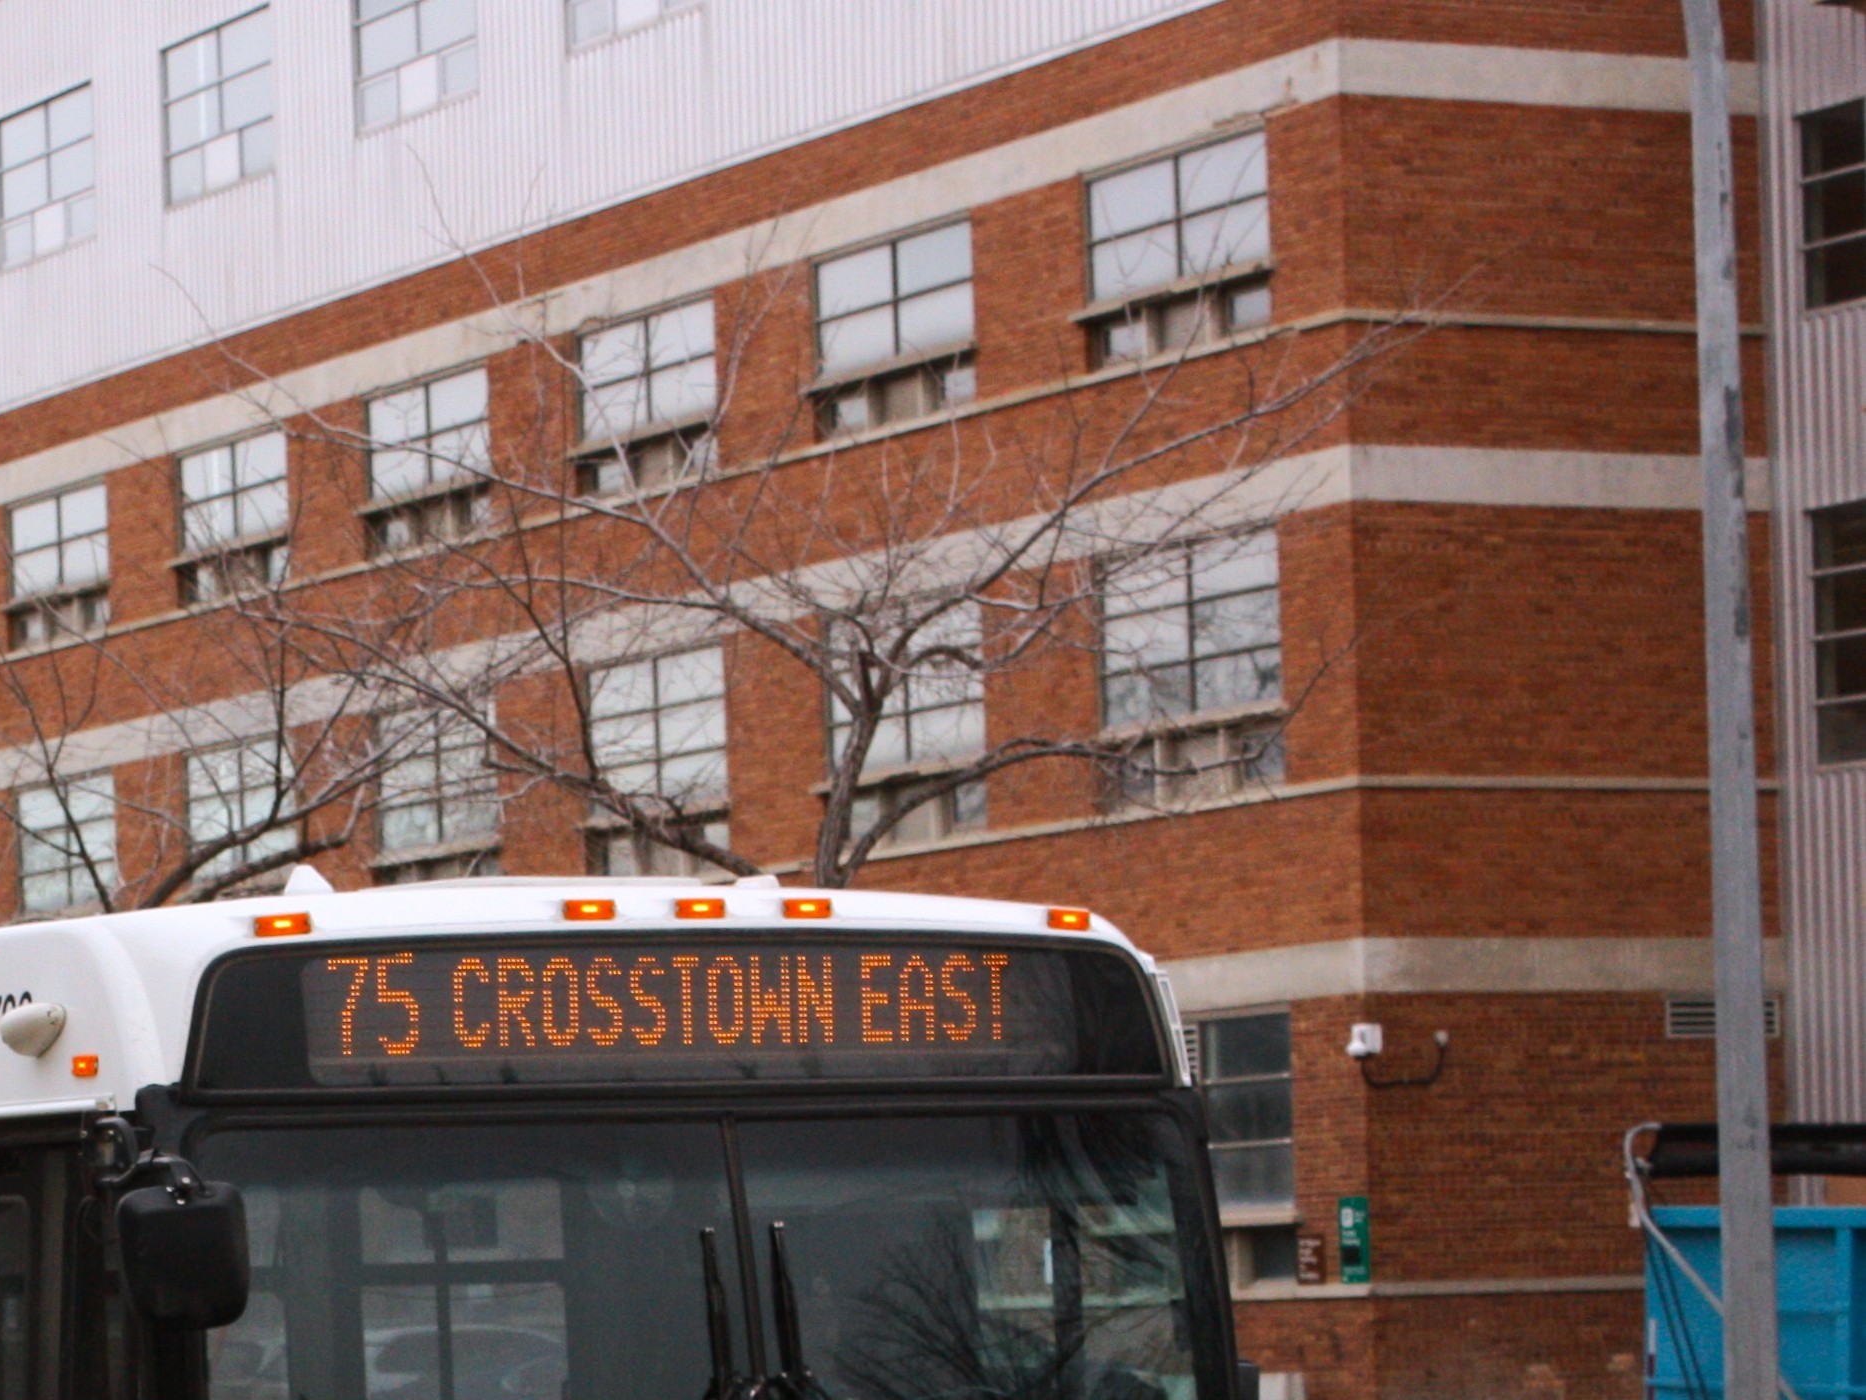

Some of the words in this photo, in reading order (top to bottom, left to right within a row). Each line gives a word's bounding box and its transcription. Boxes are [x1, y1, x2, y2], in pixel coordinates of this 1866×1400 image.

[327, 952, 420, 1056] 75
[453, 956, 834, 1048] CROSSTOWN
[860, 954, 1009, 1042] EAST
